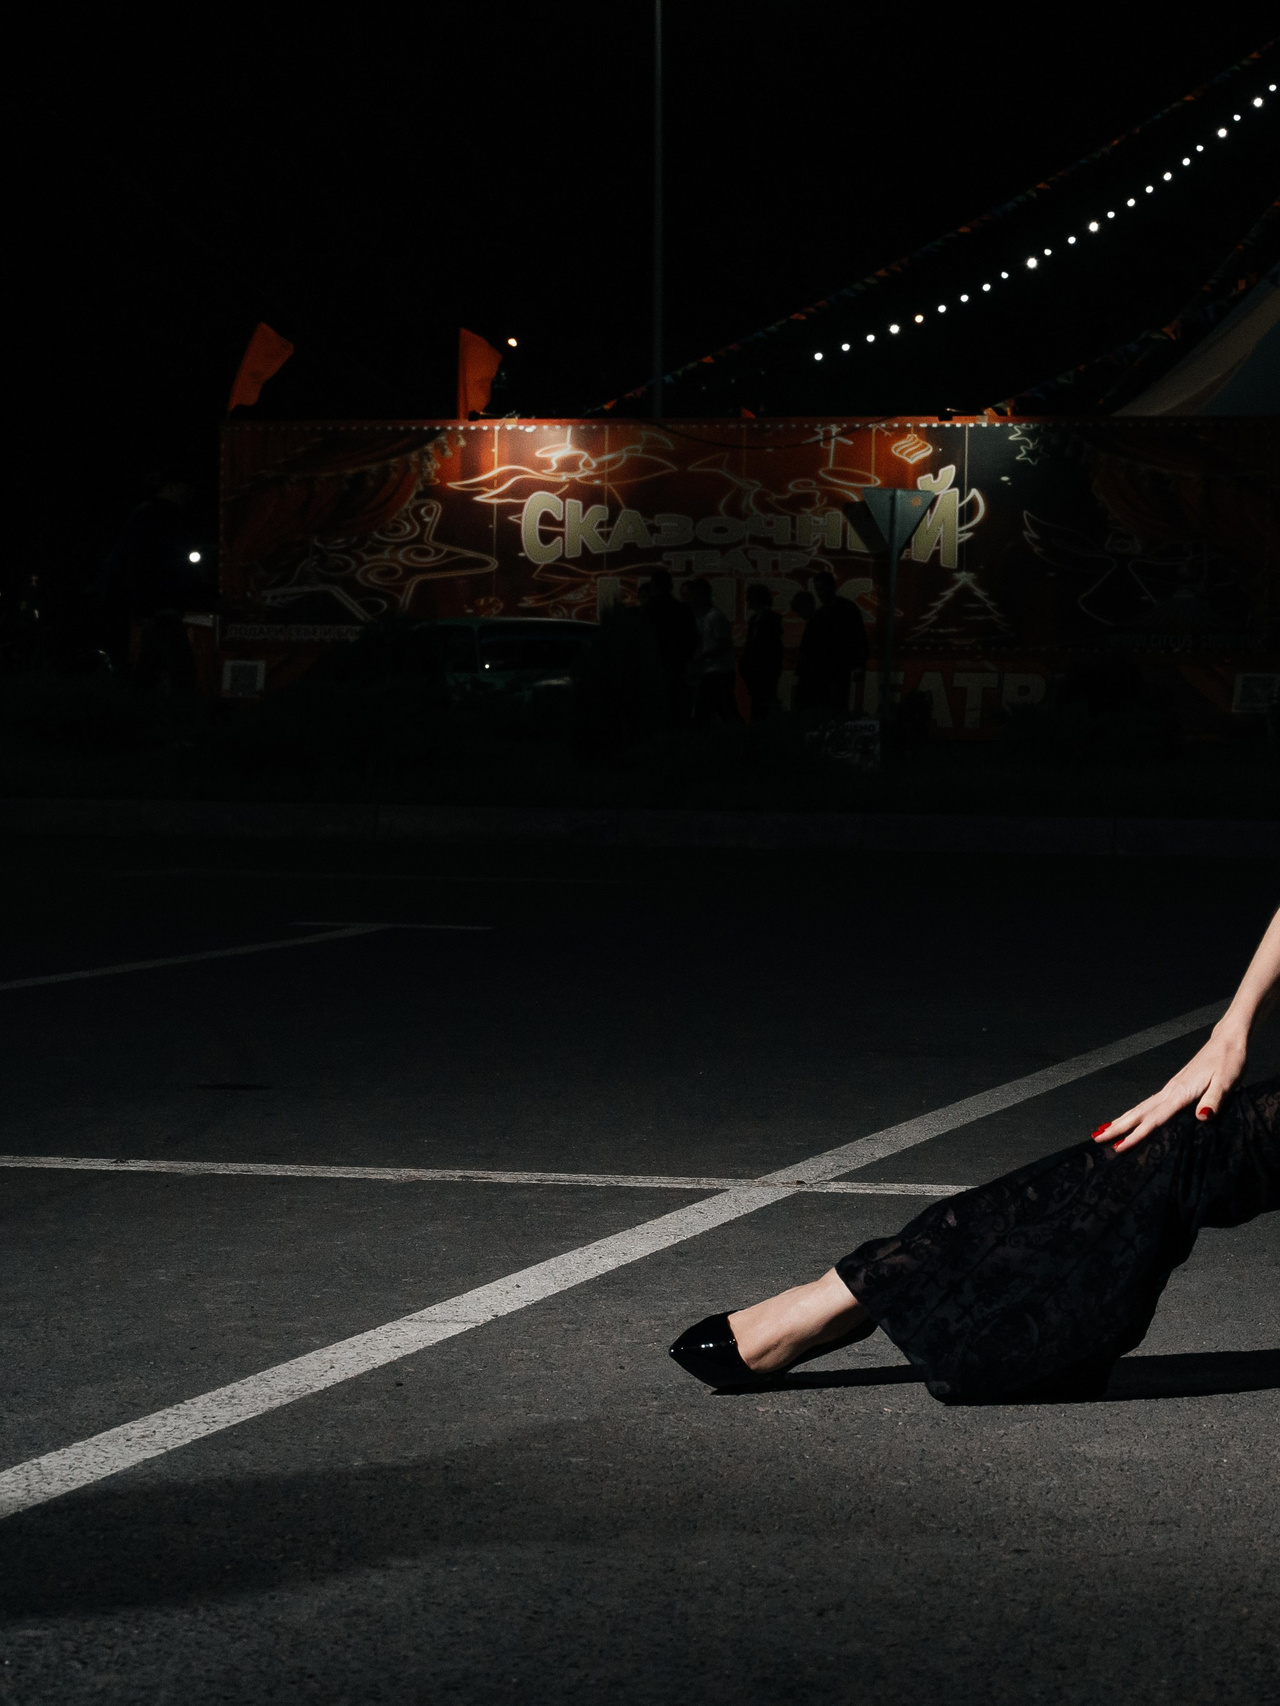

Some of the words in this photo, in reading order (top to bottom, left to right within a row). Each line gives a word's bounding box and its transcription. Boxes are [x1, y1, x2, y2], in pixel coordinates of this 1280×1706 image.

[521, 464, 966, 570] СКАЗОЧНЙ
[661, 549, 812, 574] ТЕАТР
[846, 668, 1048, 730] ЕАТР
